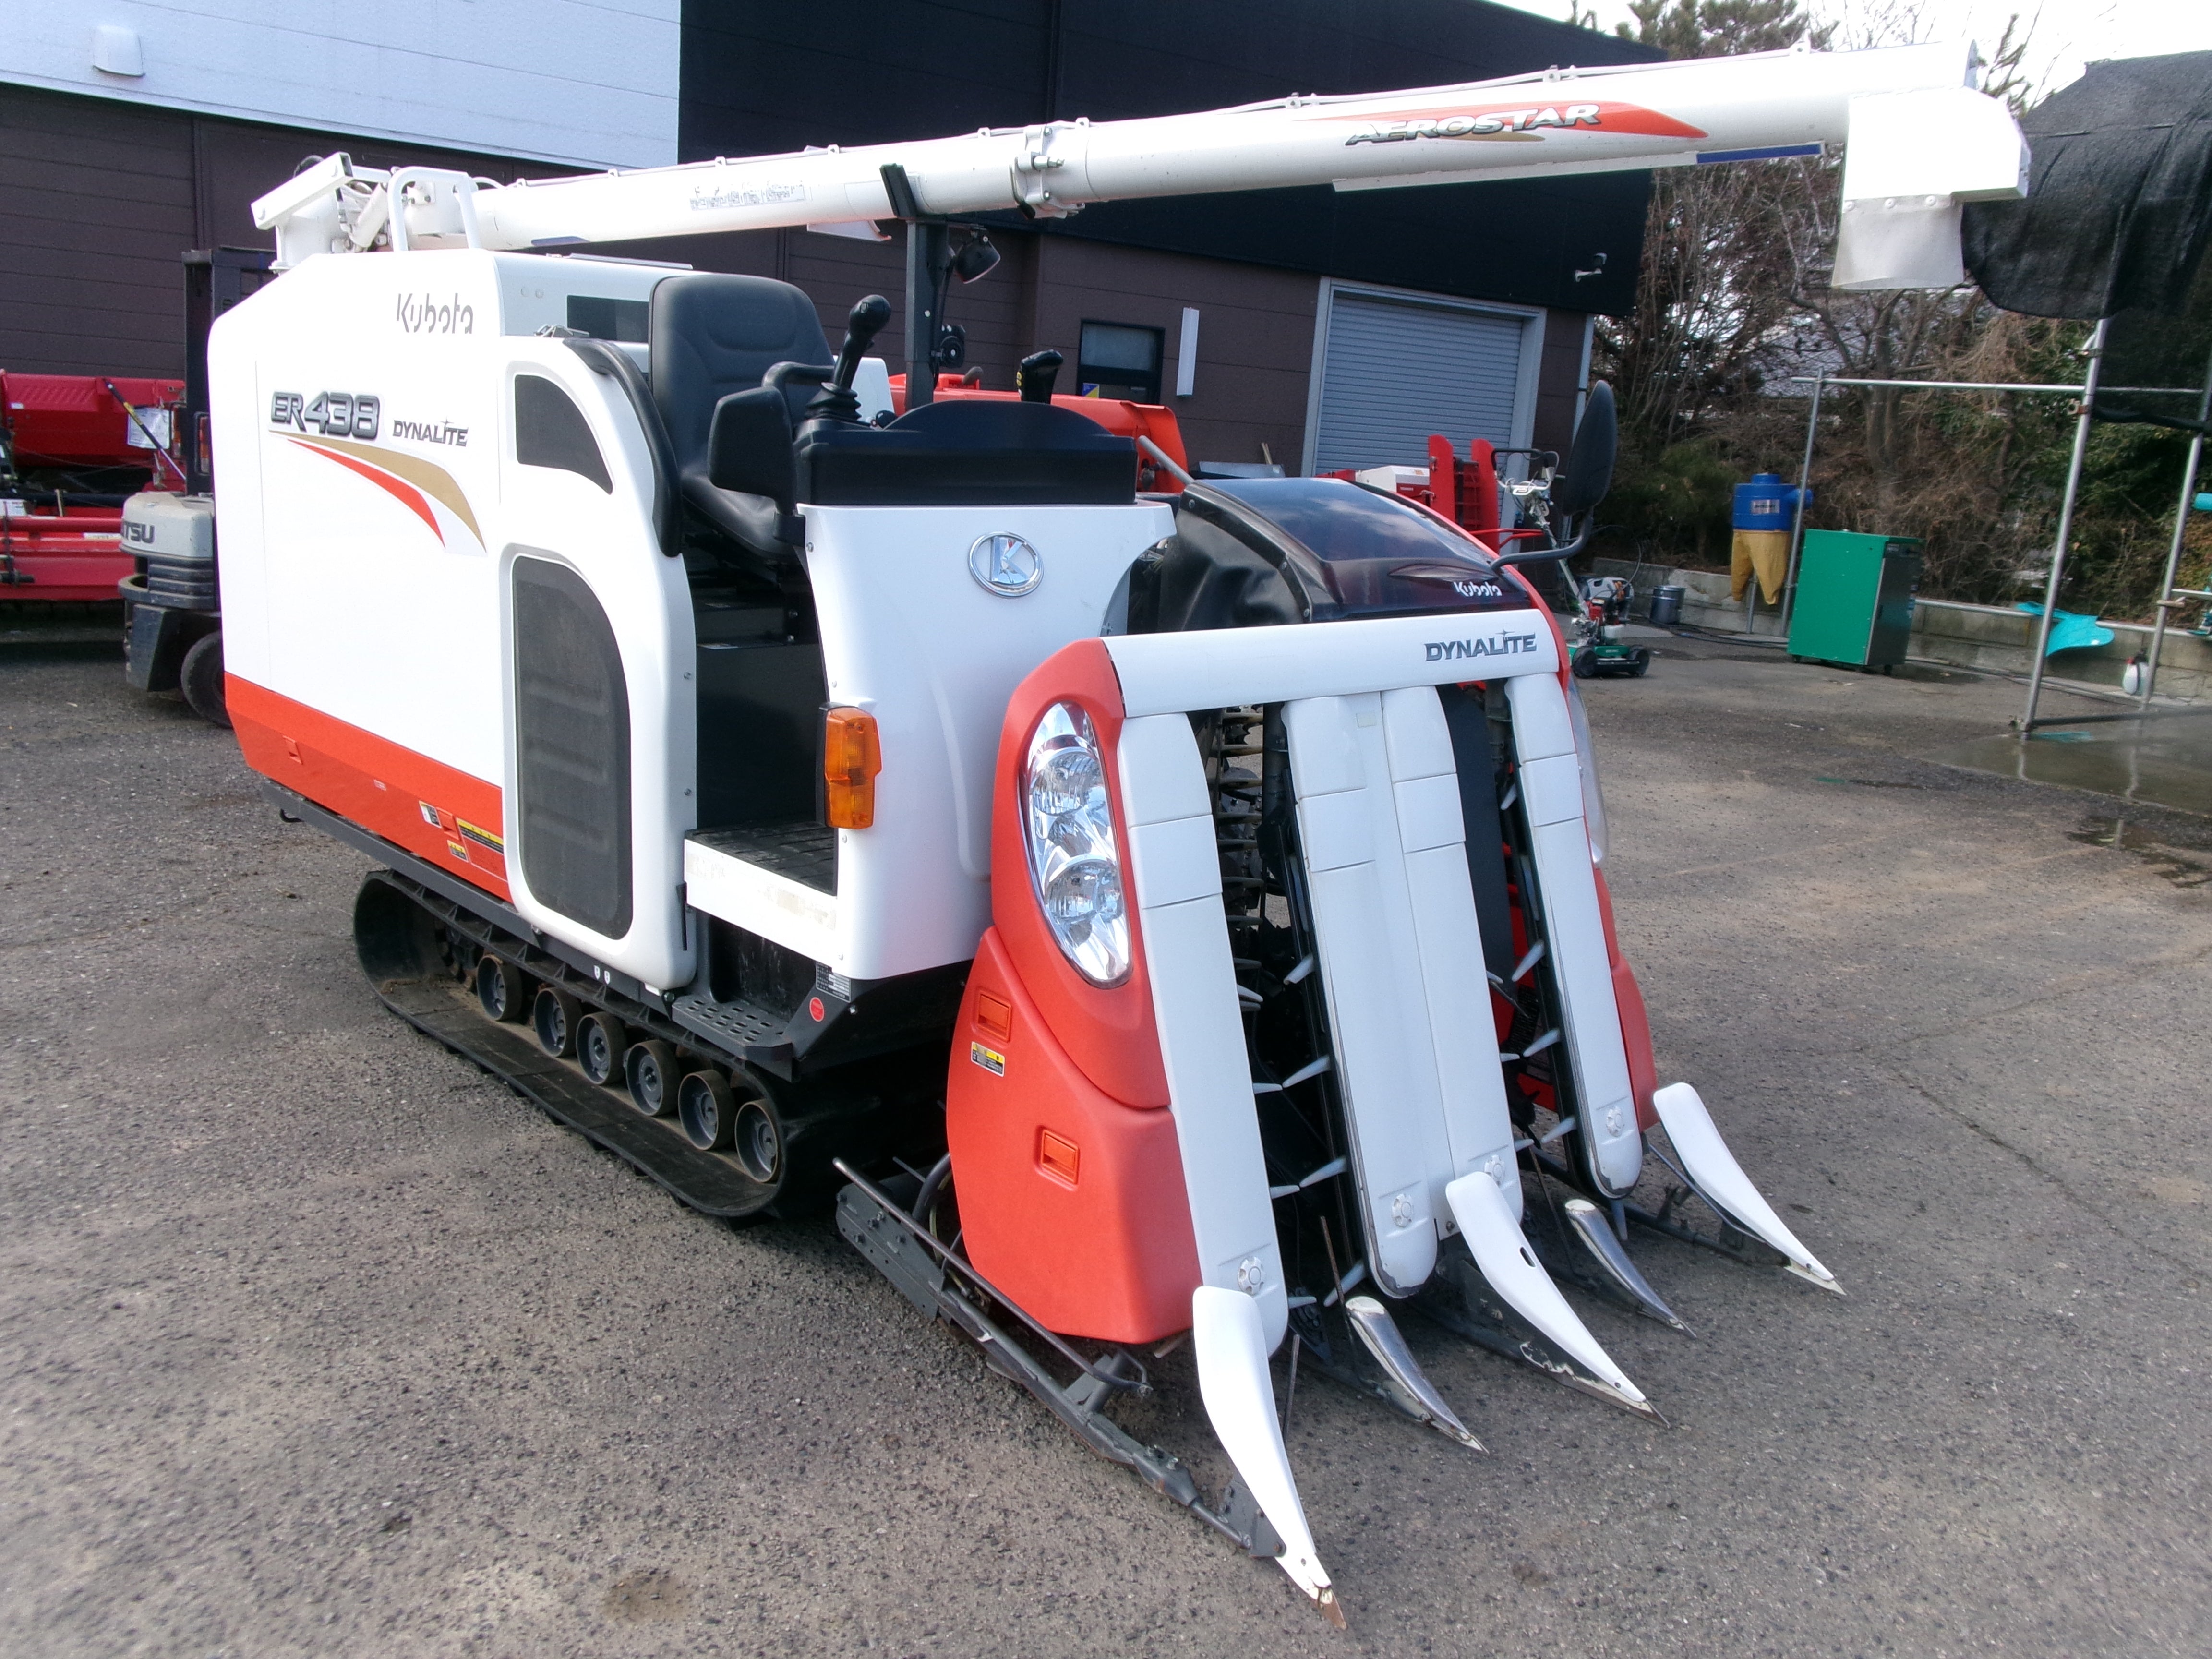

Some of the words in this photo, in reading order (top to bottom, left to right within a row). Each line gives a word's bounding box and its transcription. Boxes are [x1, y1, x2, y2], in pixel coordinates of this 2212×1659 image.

[1345, 103, 1601, 145] AEROSTAR
[397, 293, 473, 334] Kubota
[1453, 581, 1503, 597] Kubota
